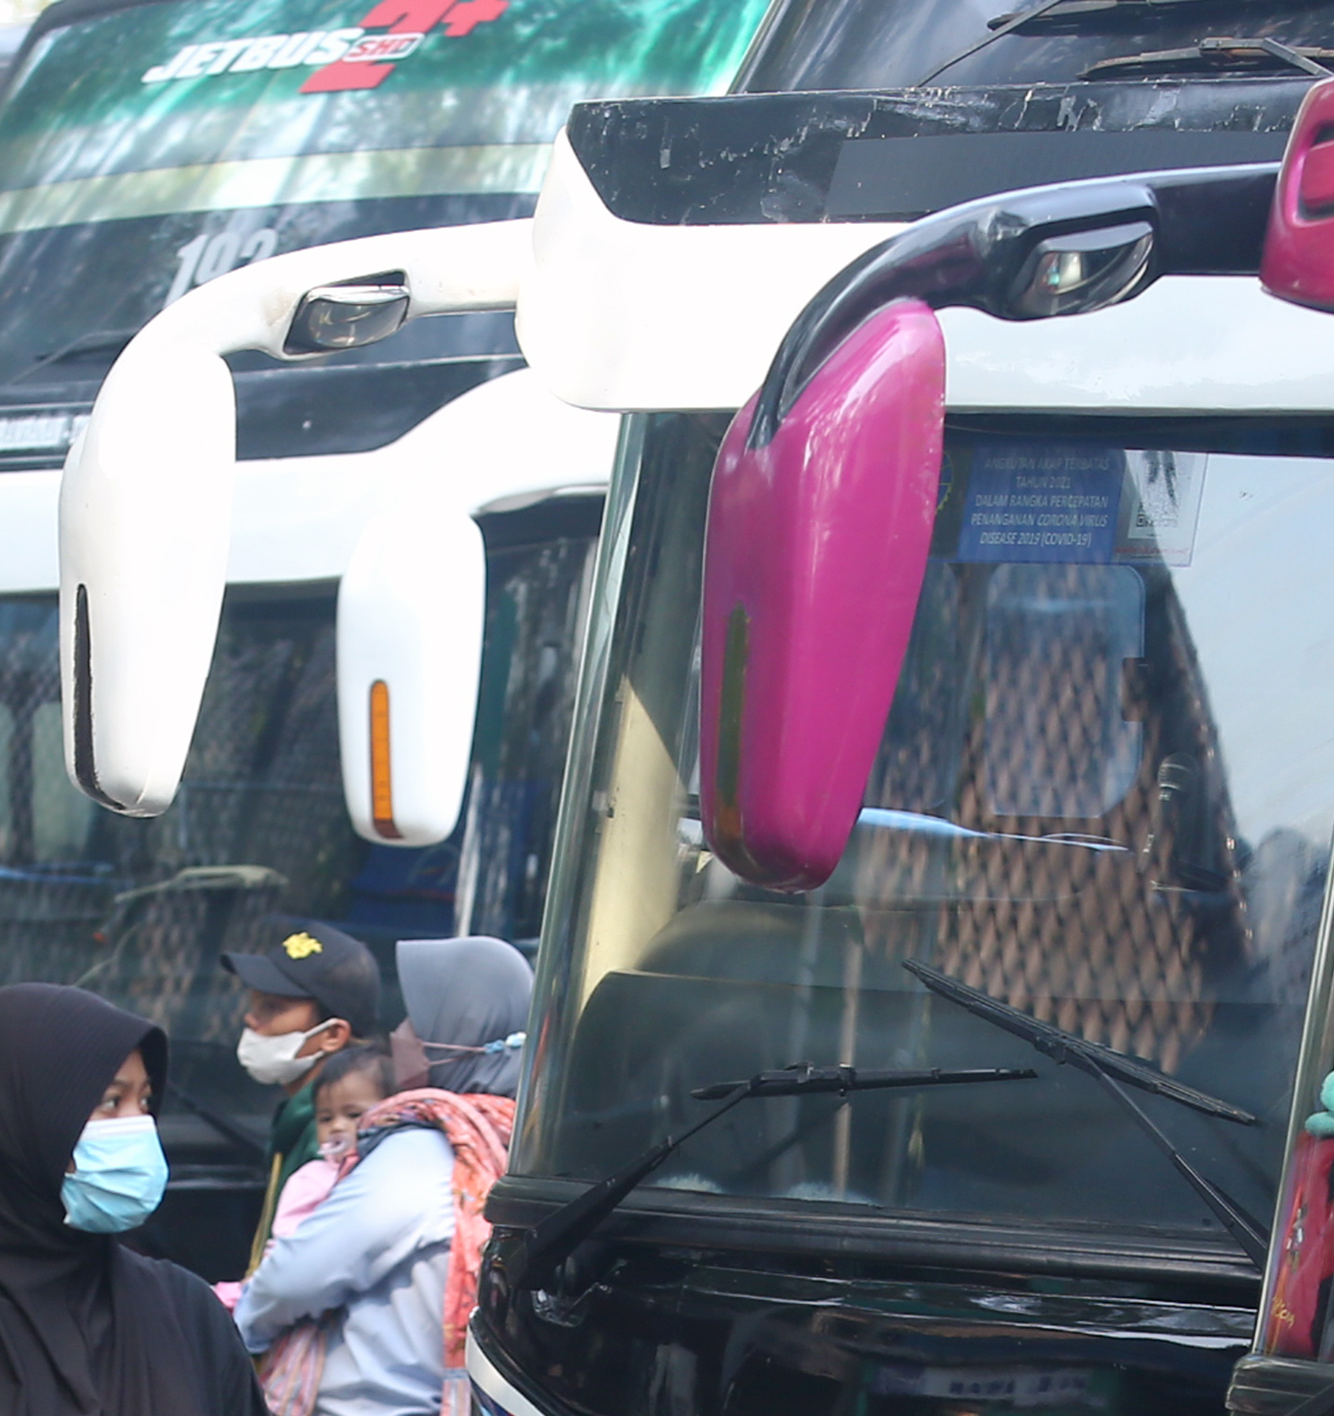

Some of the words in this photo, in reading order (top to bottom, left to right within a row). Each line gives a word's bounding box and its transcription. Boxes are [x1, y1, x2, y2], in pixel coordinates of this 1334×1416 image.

[142, 28, 365, 83] JETBUS
[1016, 476, 1048, 489] TAHUN
[975, 494, 1008, 507] DALAM
[1010, 494, 1048, 508] RANGKA
[1050, 495, 1109, 508] PERCEPATAN
[971, 513, 1034, 526] PENANGANAN
[1037, 513, 1078, 527] CORONA
[1079, 514, 1108, 527] VIRUS
[980, 532, 1016, 545] DISEASE
[1017, 533, 1040, 545] 2019
[1040, 533, 1091, 547] (COVID-19)
